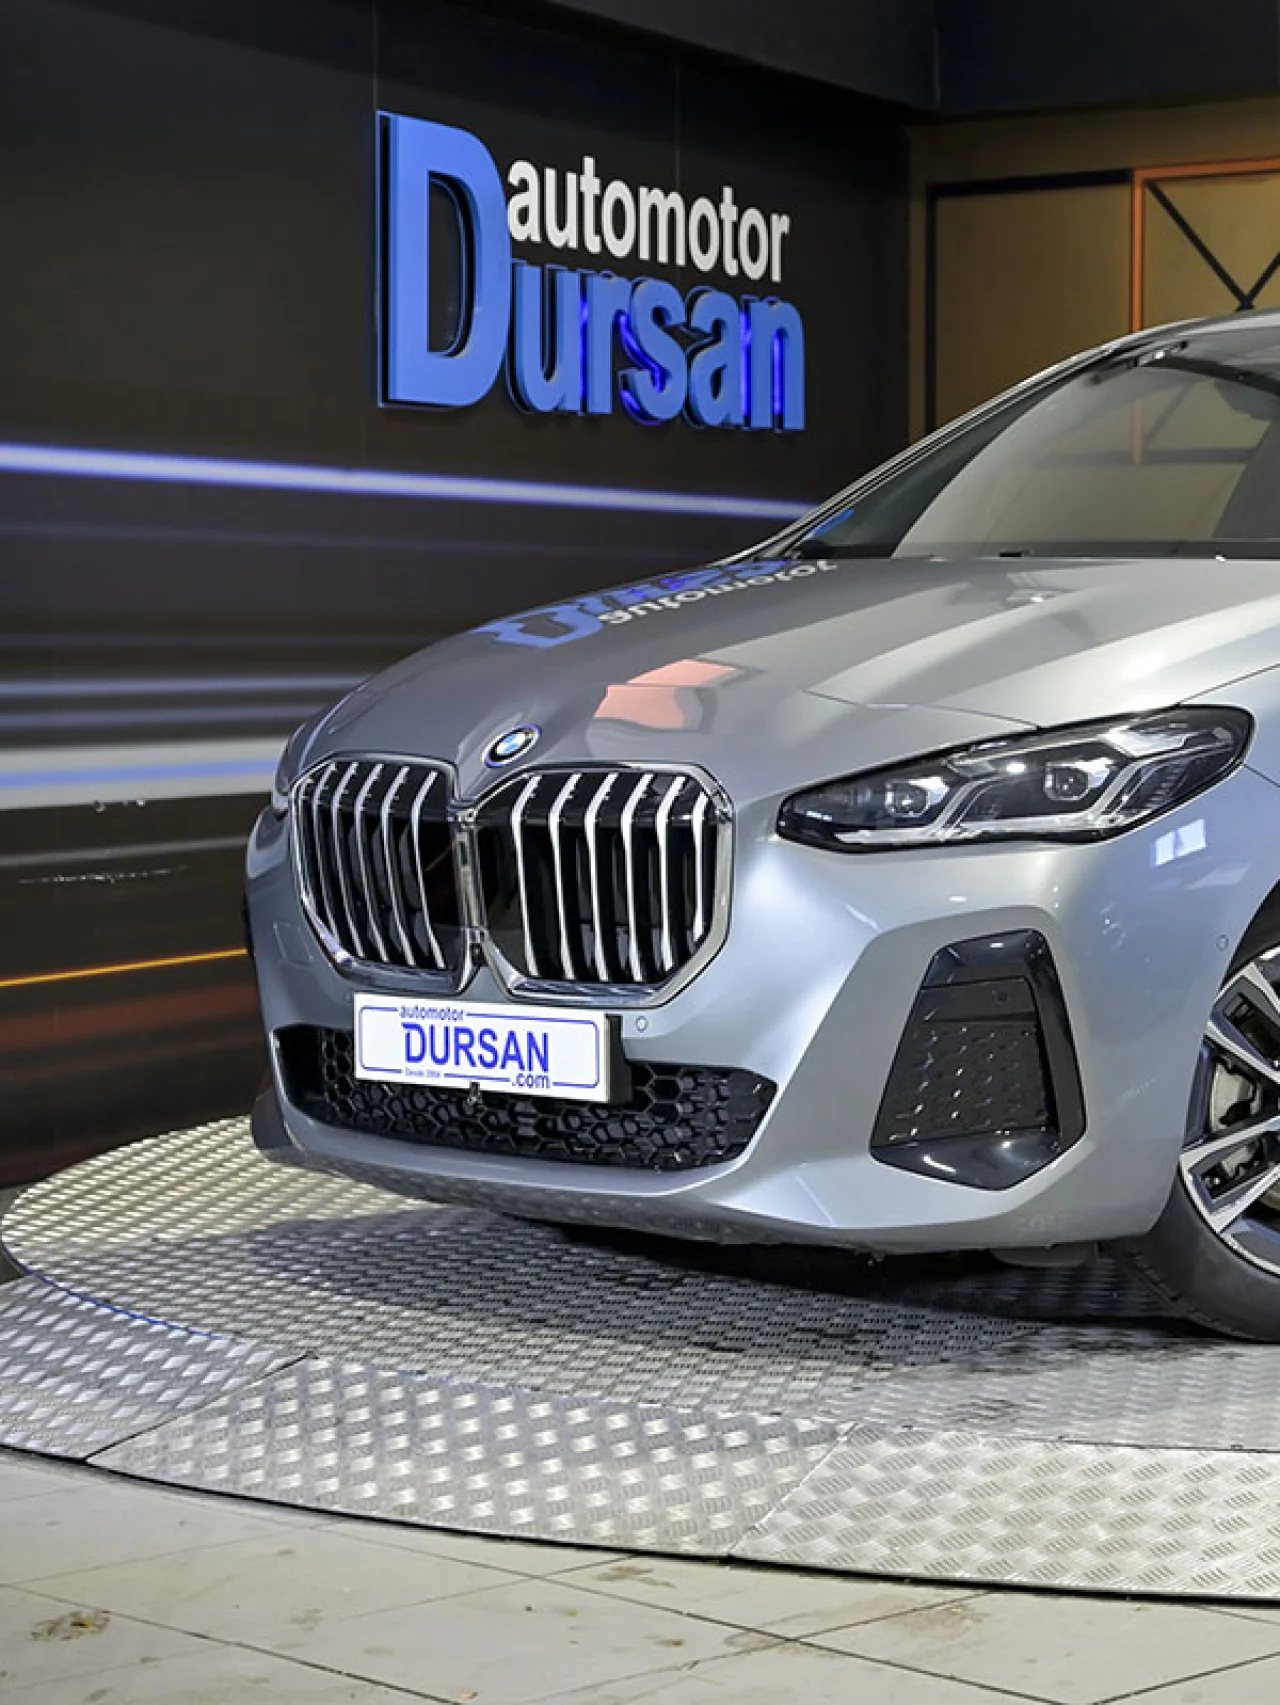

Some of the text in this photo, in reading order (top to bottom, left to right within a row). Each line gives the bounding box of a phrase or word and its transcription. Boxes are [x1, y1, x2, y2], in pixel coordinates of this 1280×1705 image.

[508, 156, 790, 283] automotor
[376, 110, 806, 433] Dursan
[399, 1004, 466, 1022] automotor
[400, 1021, 550, 1073] DURSAN
[511, 1071, 550, 1089] .com
